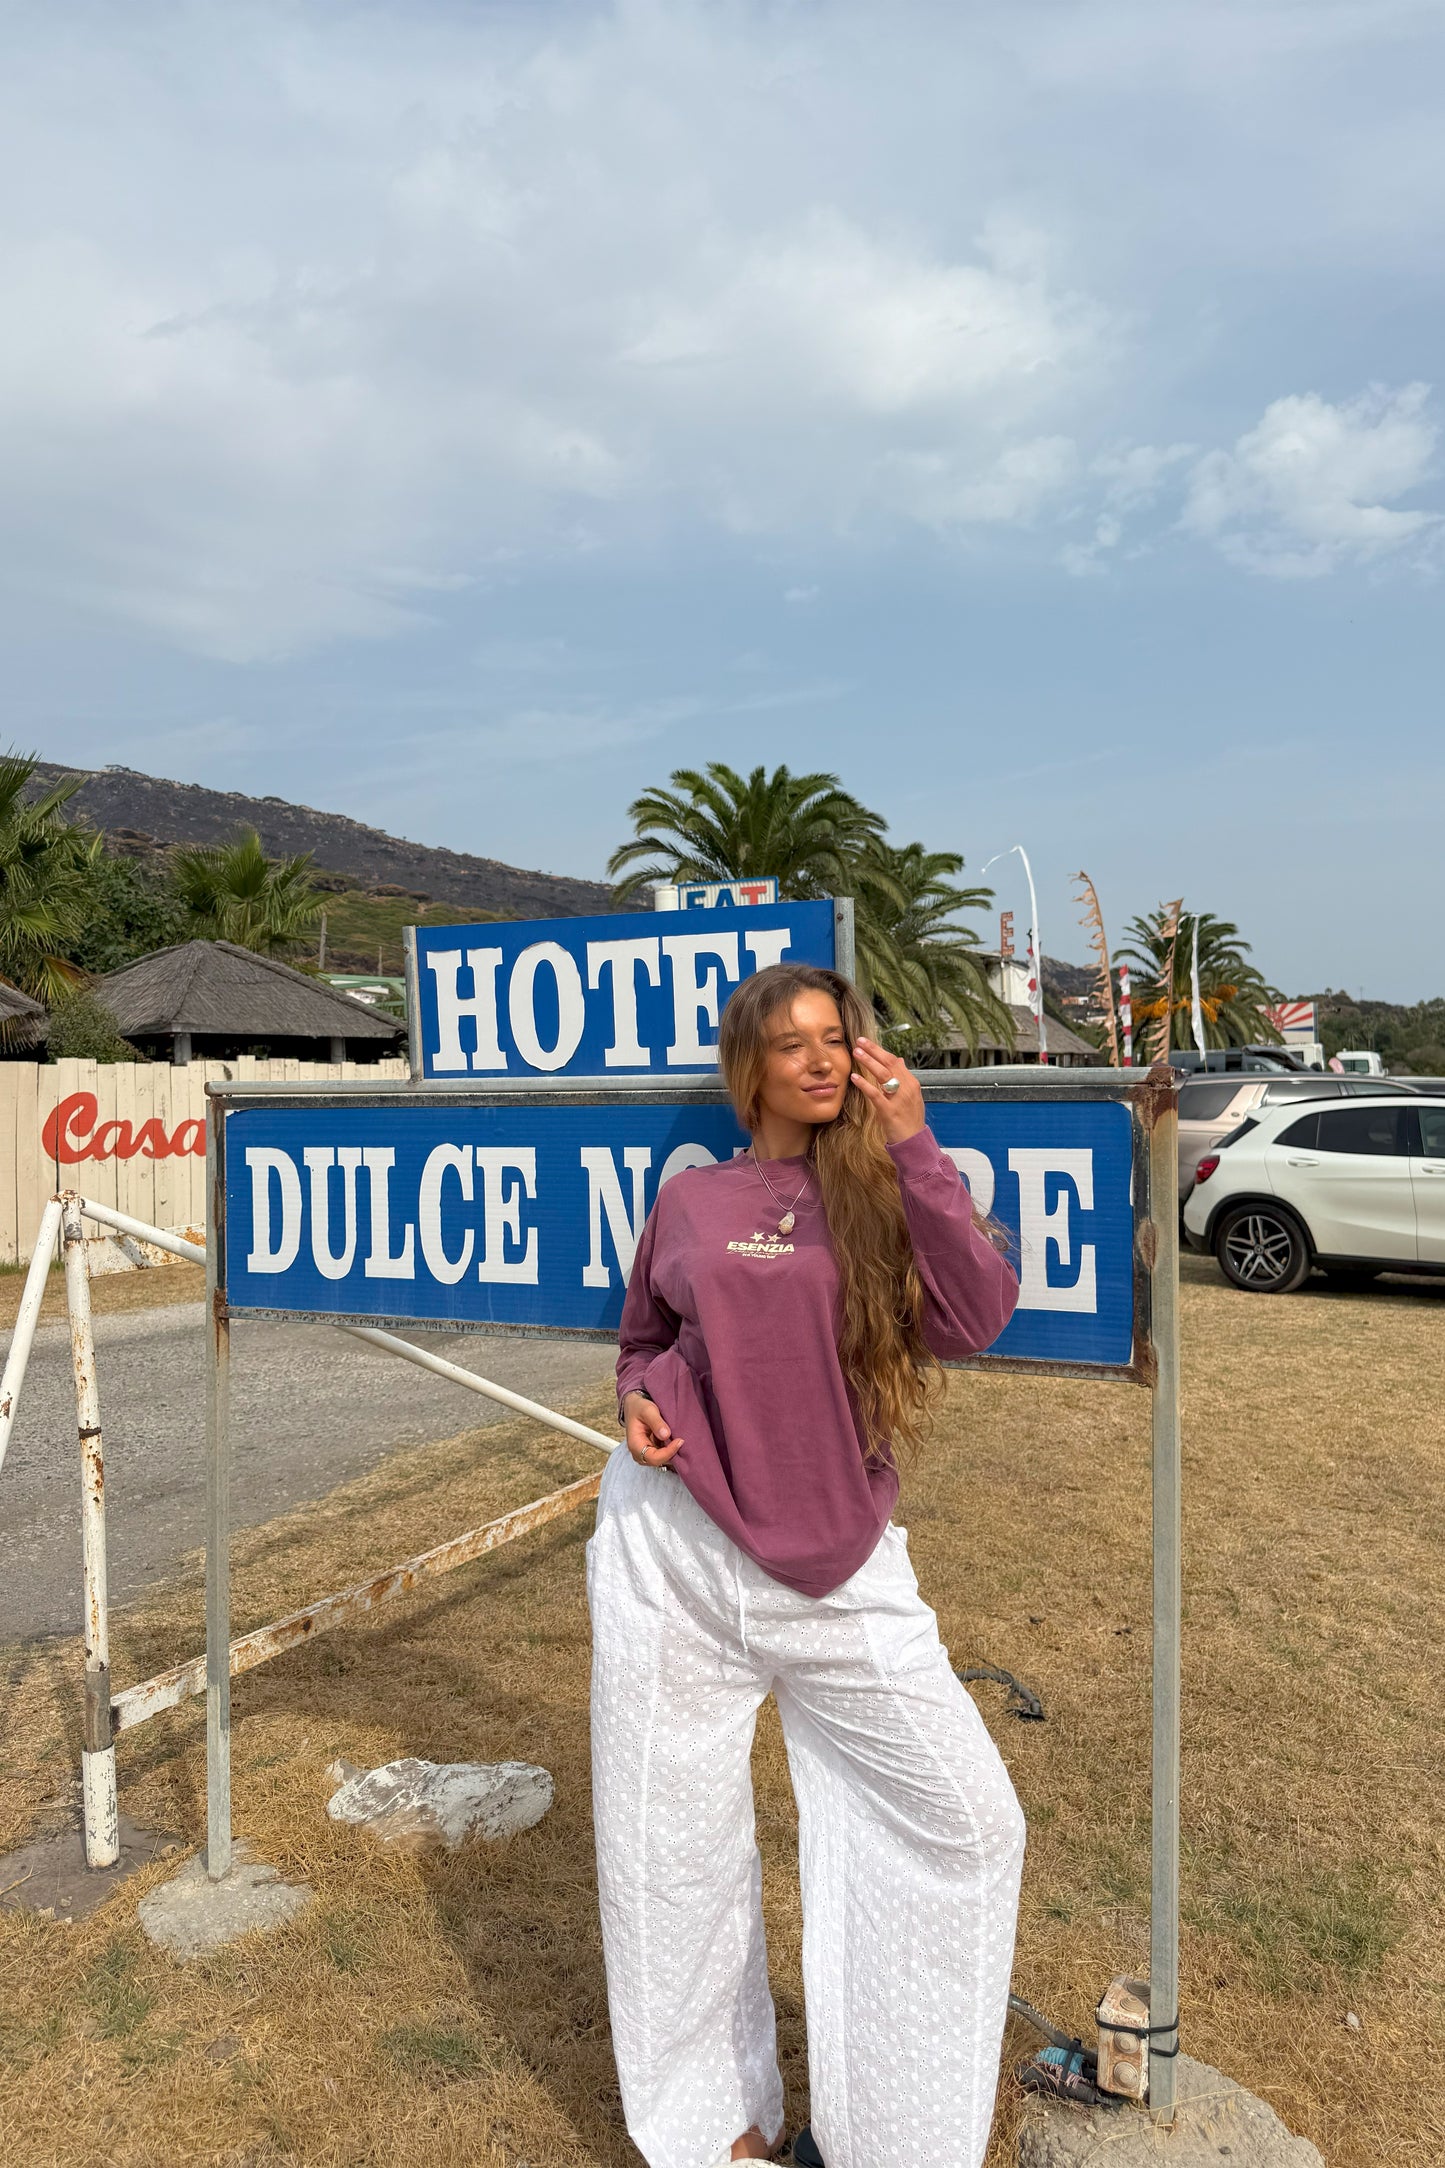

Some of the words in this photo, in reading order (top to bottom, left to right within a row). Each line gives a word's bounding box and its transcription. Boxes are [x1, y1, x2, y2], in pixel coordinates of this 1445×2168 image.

[42, 1091, 207, 1164] Casa
[245, 1142, 539, 1285] DULCE
[726, 1241, 795, 1253] ESENZIA
